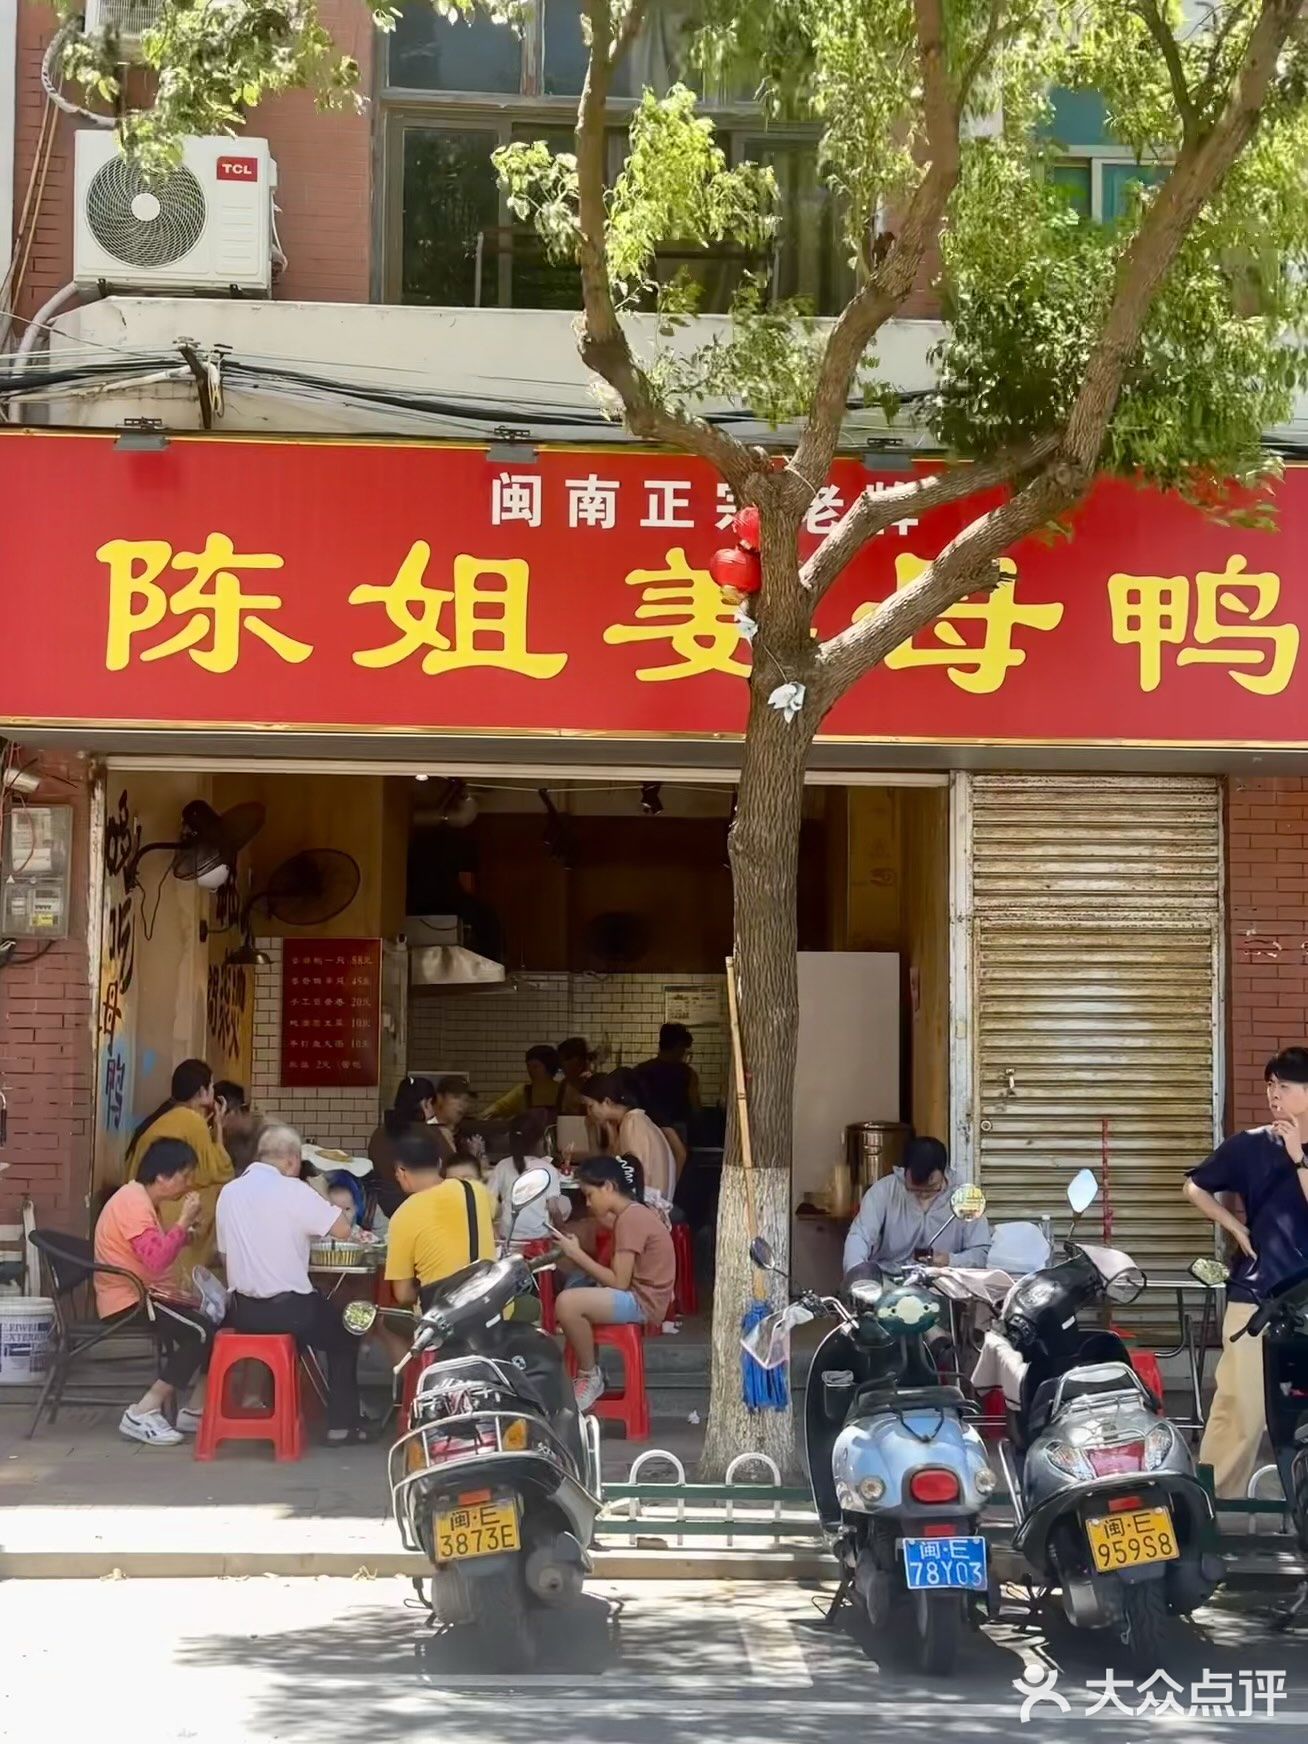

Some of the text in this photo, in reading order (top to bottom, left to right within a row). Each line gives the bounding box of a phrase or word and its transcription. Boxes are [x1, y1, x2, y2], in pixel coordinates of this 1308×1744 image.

[221, 163, 252, 175] TCL
[96, 531, 1300, 696] 陈姐姜母鸭
[439, 1524, 515, 1557] 3873E
[1097, 1532, 1173, 1567] 959S8
[909, 1562, 983, 1586] 78Y03
